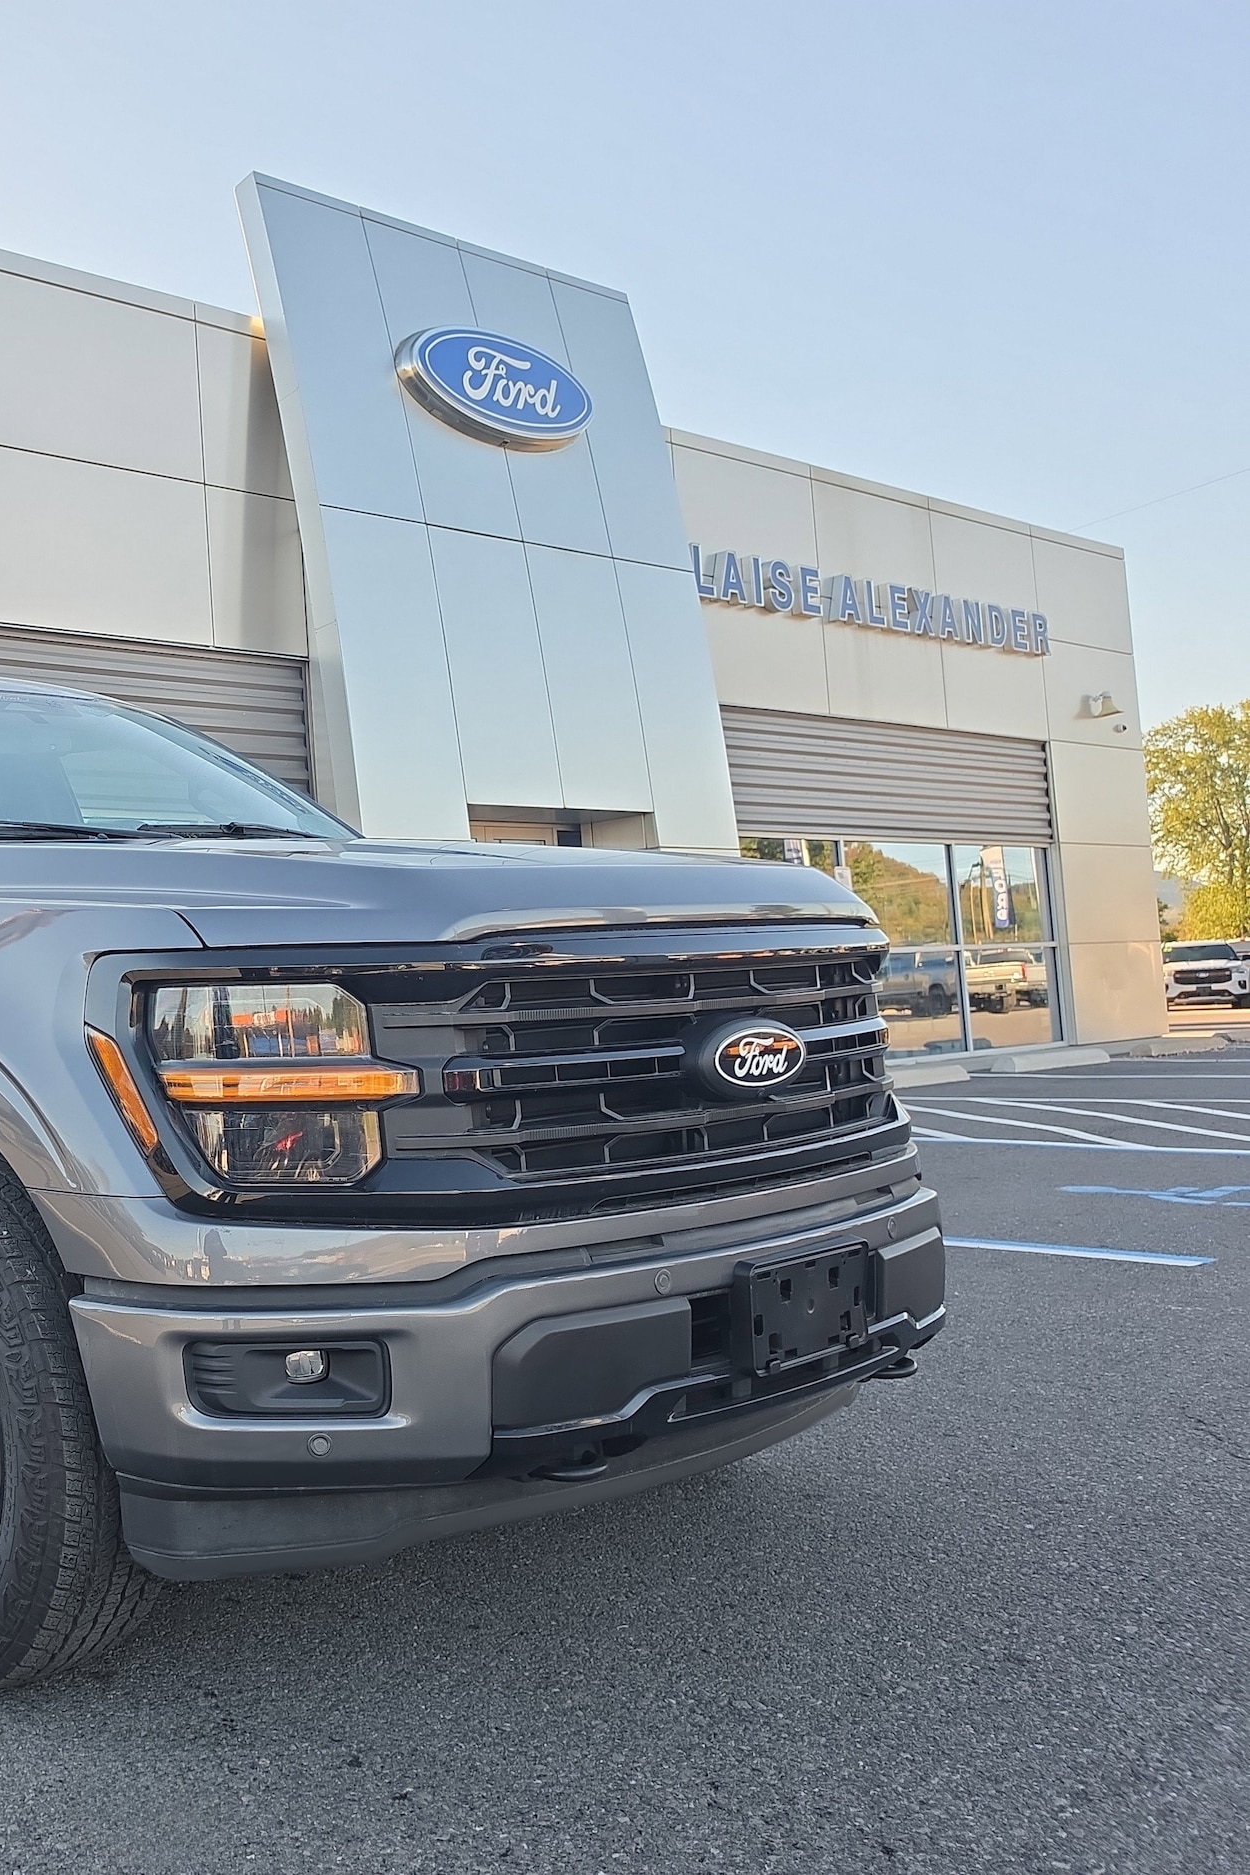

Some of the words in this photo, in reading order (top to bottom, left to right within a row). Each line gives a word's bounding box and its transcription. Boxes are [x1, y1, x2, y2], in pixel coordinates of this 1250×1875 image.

[462, 346, 561, 418] Ford
[839, 574, 1051, 656] ALEXANDER
[734, 1037, 788, 1077] Ford
